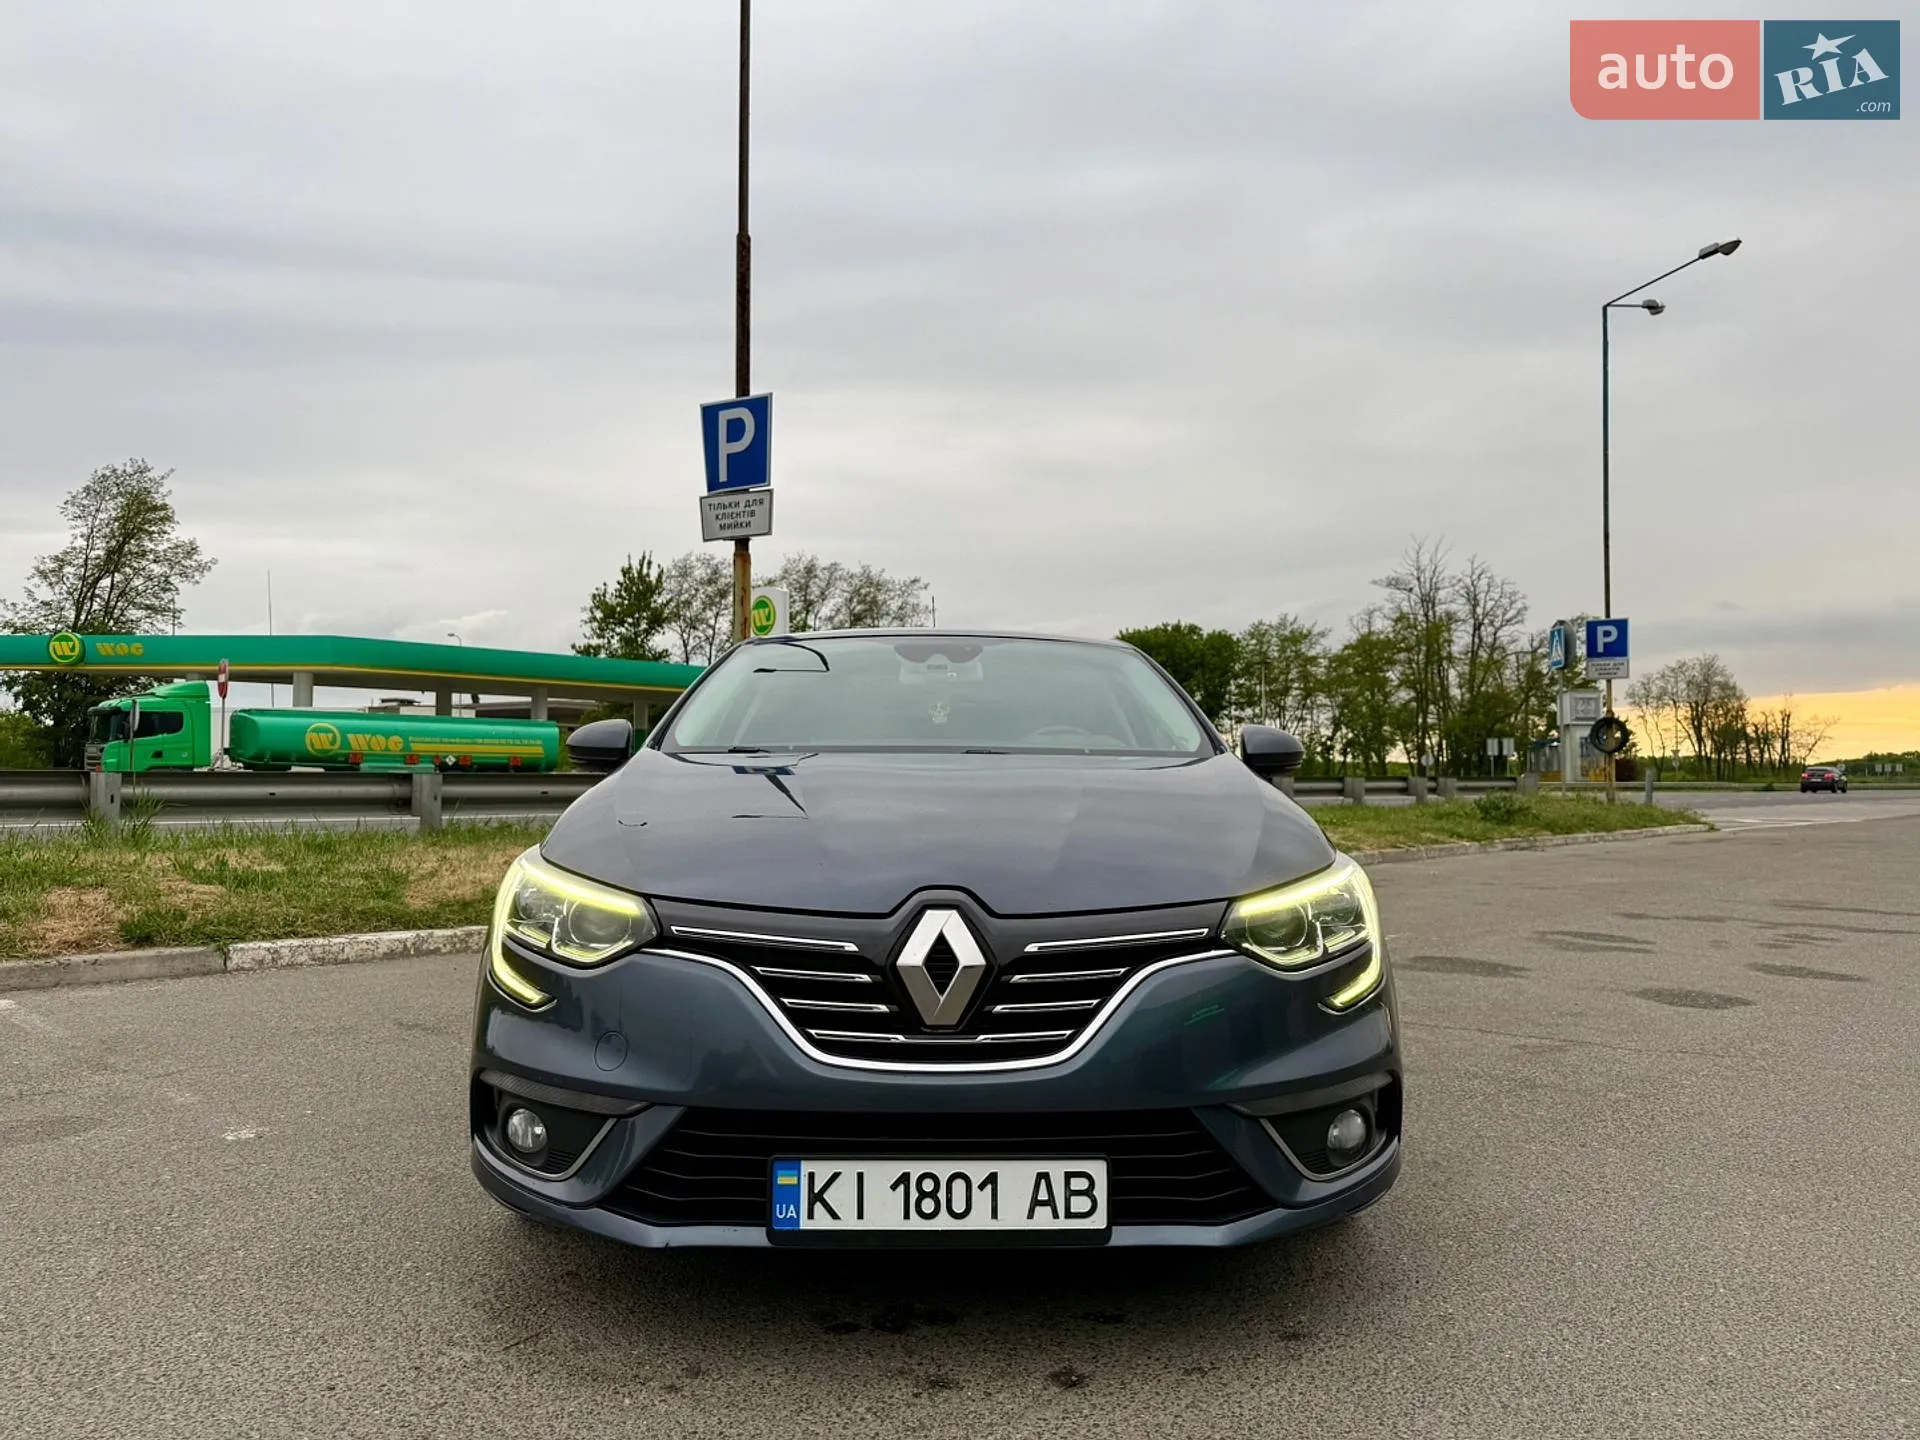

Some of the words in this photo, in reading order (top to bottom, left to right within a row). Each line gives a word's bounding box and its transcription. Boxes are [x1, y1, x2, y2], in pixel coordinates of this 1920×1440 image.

[717, 406, 756, 483] P
[708, 500, 740, 512] ТІЛЬКИ
[743, 497, 764, 509] ДЛЯ
[719, 520, 752, 531] МИЙКИ
[1596, 625, 1618, 653] P
[95, 642, 145, 657] WOG
[346, 733, 404, 752] WOG
[806, 1170, 865, 1221] KI
[889, 1170, 999, 1221] 1801
[1026, 1170, 1098, 1221] AB
[775, 1203, 798, 1219] UA
